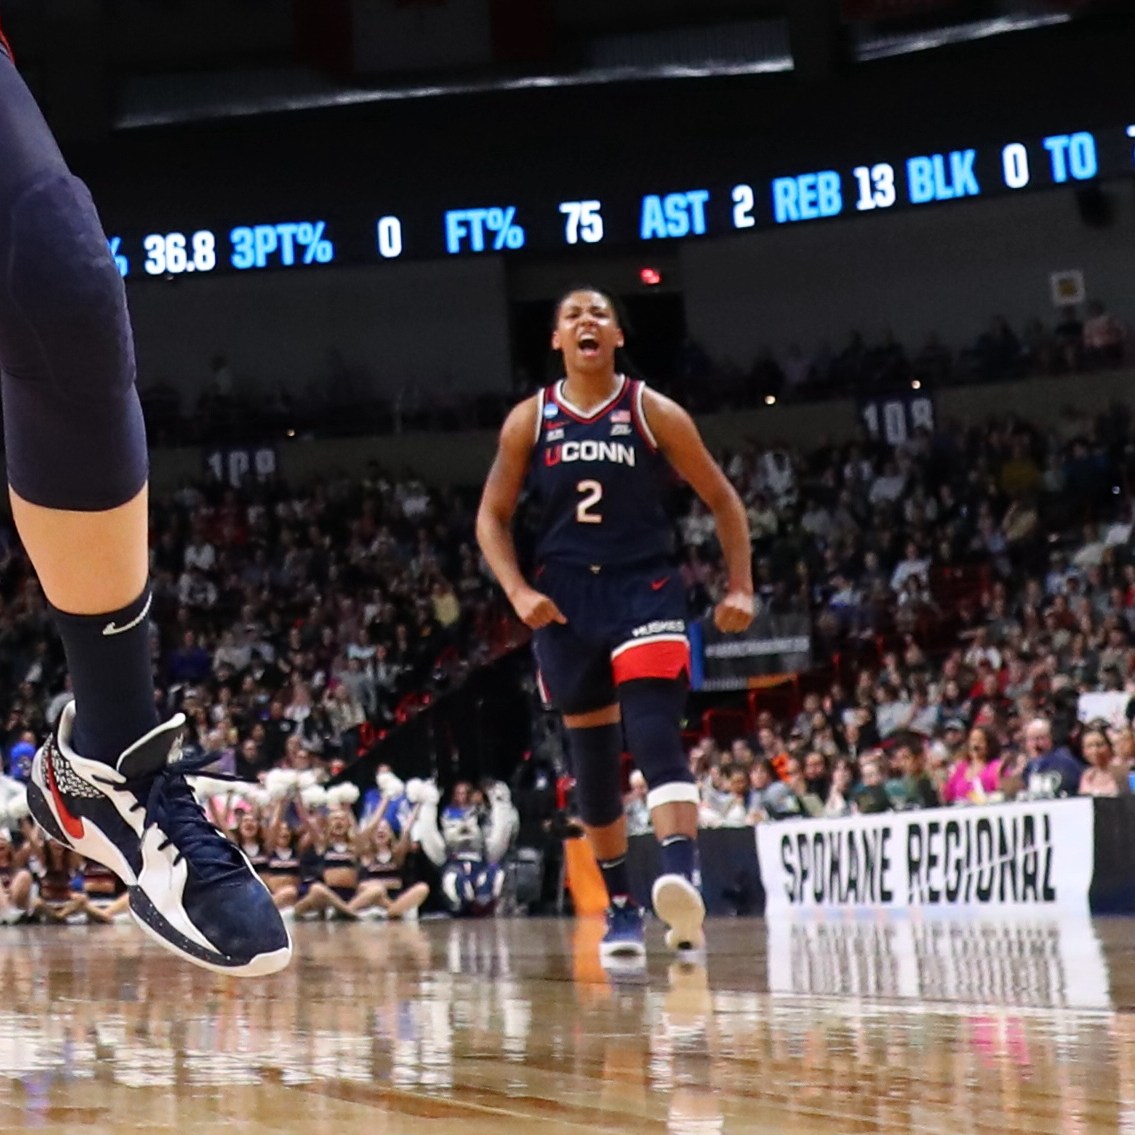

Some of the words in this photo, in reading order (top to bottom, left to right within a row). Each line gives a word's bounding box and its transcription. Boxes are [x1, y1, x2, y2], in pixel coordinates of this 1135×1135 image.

[143, 231, 216, 275] 36.8
[230, 221, 334, 269] 3PT%
[377, 216, 403, 258] 0
[444, 206, 525, 254] FT%
[560, 200, 604, 244] 75
[640, 190, 710, 240] AST
[732, 184, 756, 229] 2
[771, 170, 843, 224] REB
[853, 163, 896, 211] 13
[906, 149, 981, 204] BLK
[1002, 142, 1030, 188] 0
[1043, 131, 1098, 183] TO
[544, 439, 636, 467] UCONN
[576, 478, 603, 524] 2
[780, 826, 893, 904] SPOKANE
[906, 813, 1057, 904] REGIONAL
